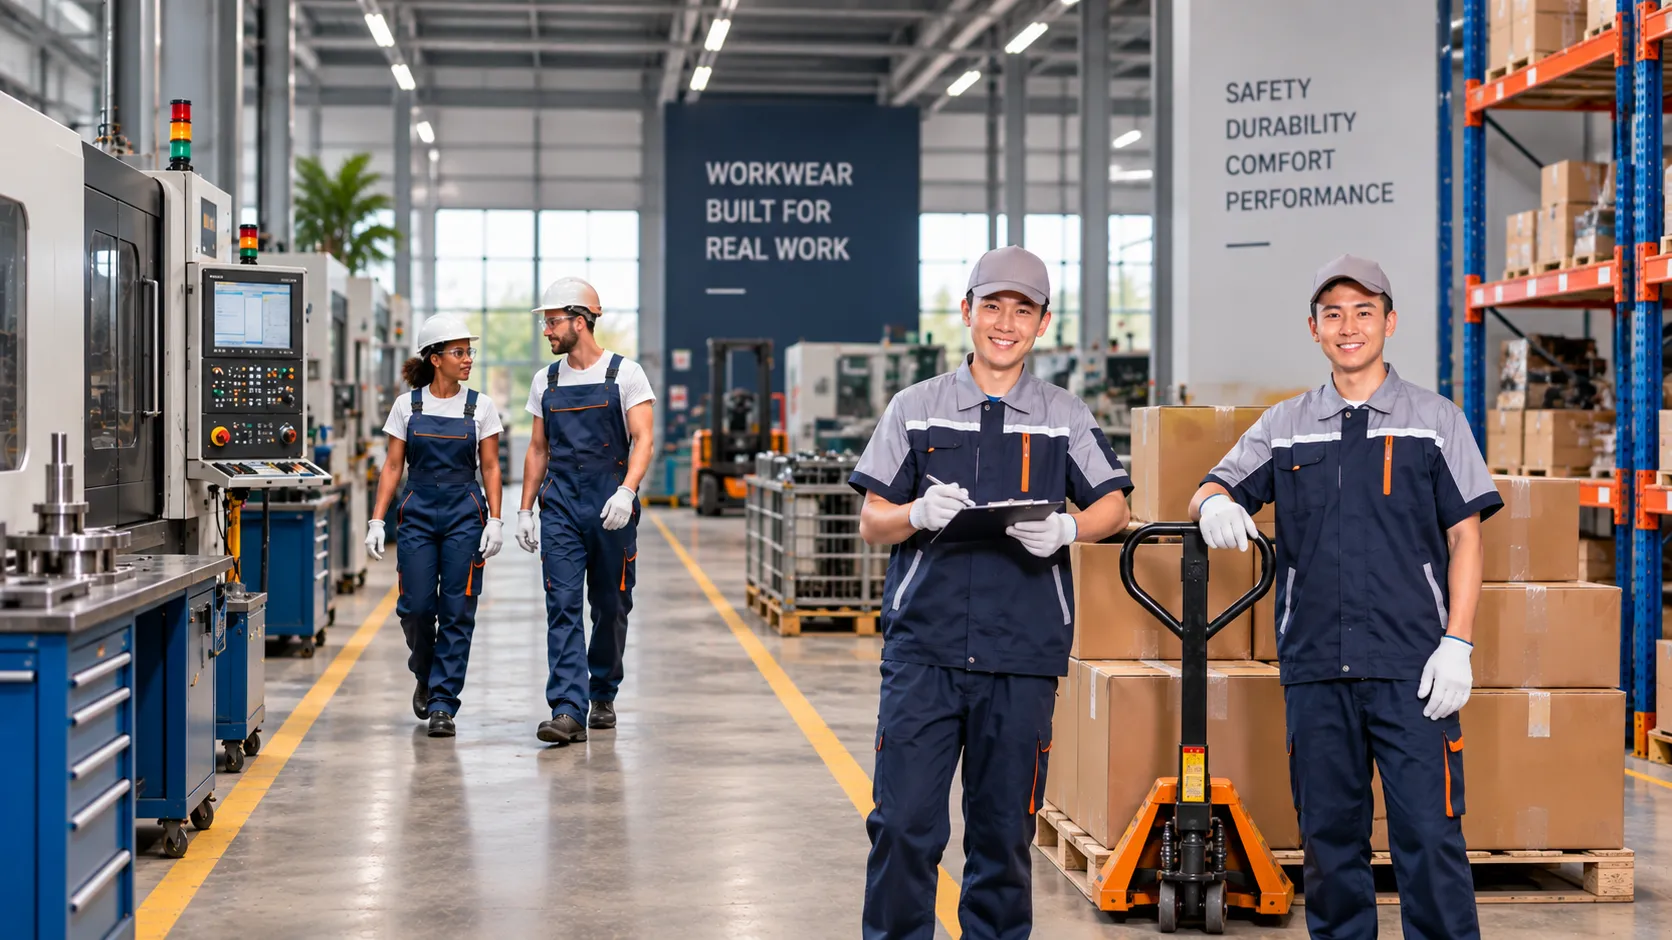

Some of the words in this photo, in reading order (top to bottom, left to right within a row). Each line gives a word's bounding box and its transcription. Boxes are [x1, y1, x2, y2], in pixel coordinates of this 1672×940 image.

[1225, 77, 1312, 104] SAFETY
[1225, 111, 1357, 140] DURABILITY
[705, 161, 853, 186] WORKWEAR
[1225, 148, 1336, 176] COMFORT
[1226, 181, 1395, 212] PERFORMANCE
[706, 198, 776, 223] BUILT
[782, 198, 832, 224] FOR
[706, 236, 769, 261] REAL
[774, 236, 850, 261] WORK
